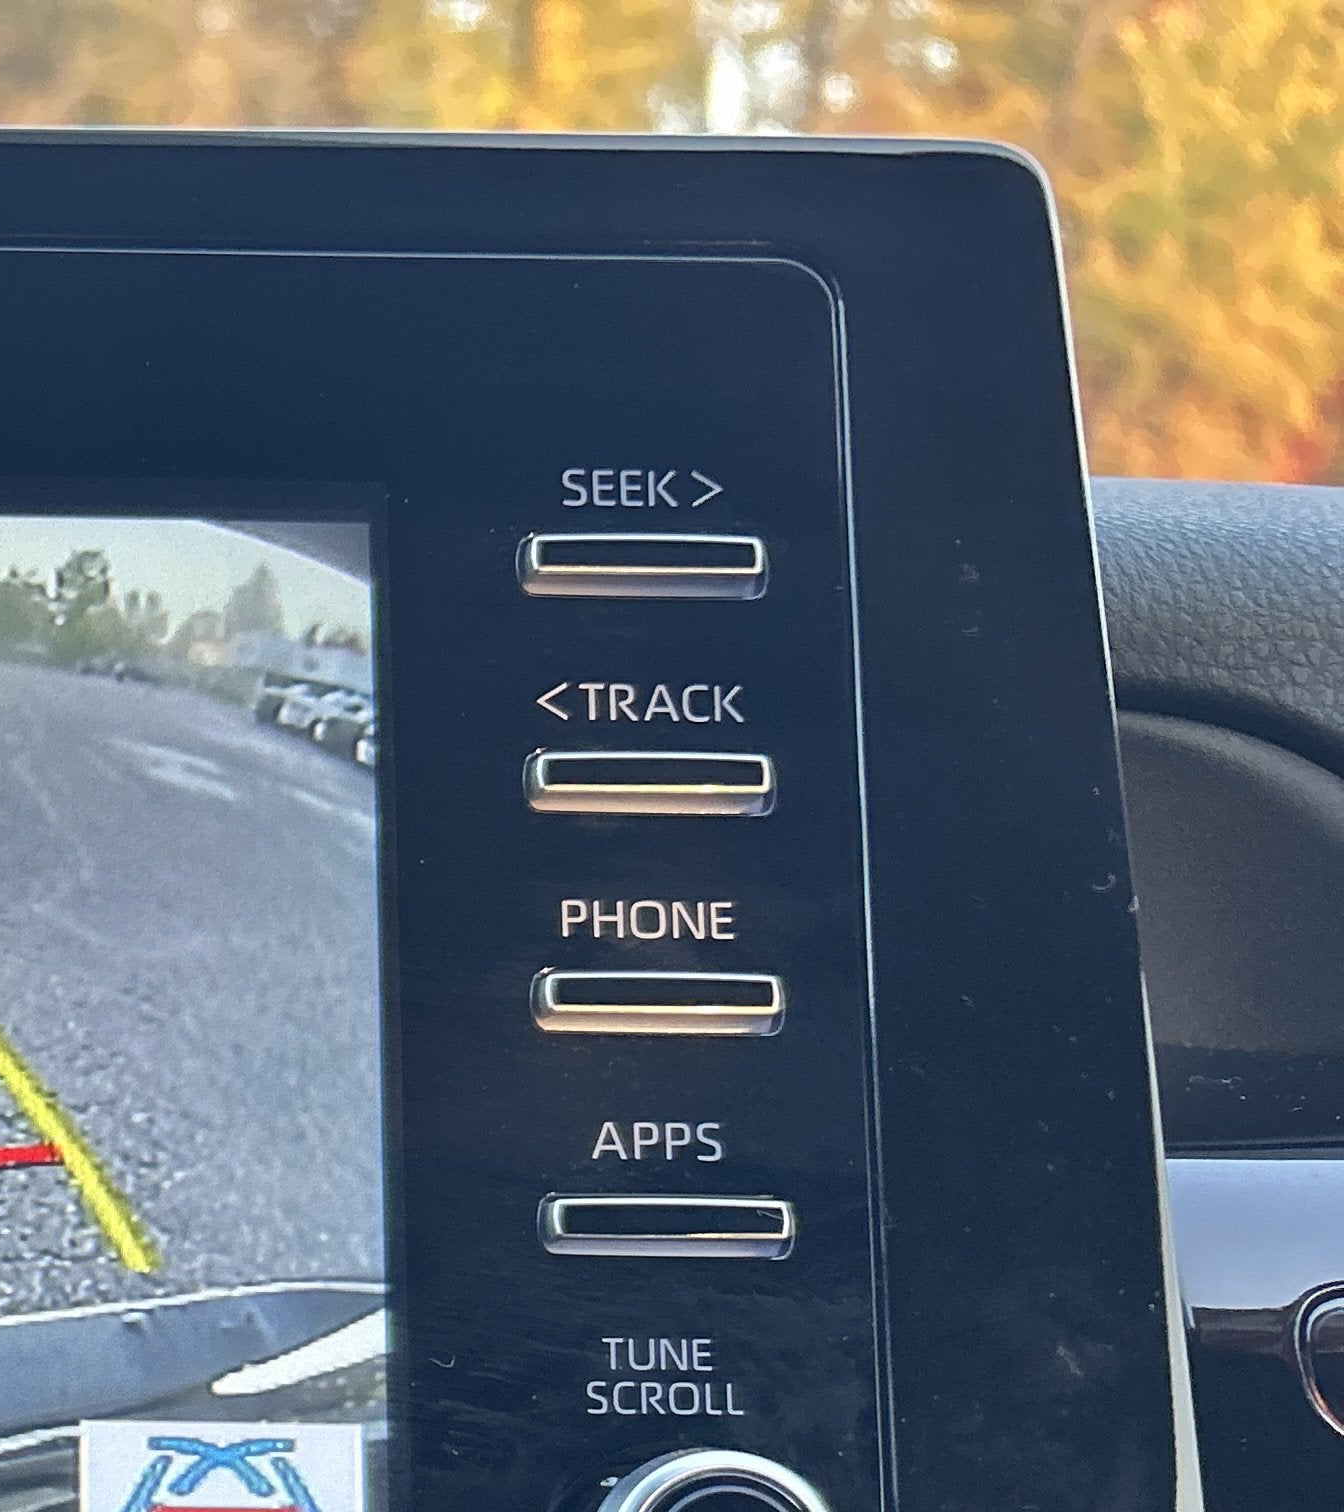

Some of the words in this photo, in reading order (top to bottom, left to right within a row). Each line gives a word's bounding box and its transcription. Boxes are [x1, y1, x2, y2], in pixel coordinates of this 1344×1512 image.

[561, 899, 735, 940] PHONE
[591, 1121, 722, 1162] APPS
[601, 1337, 713, 1372] TUNE
[586, 1380, 745, 1416] SCROLL
